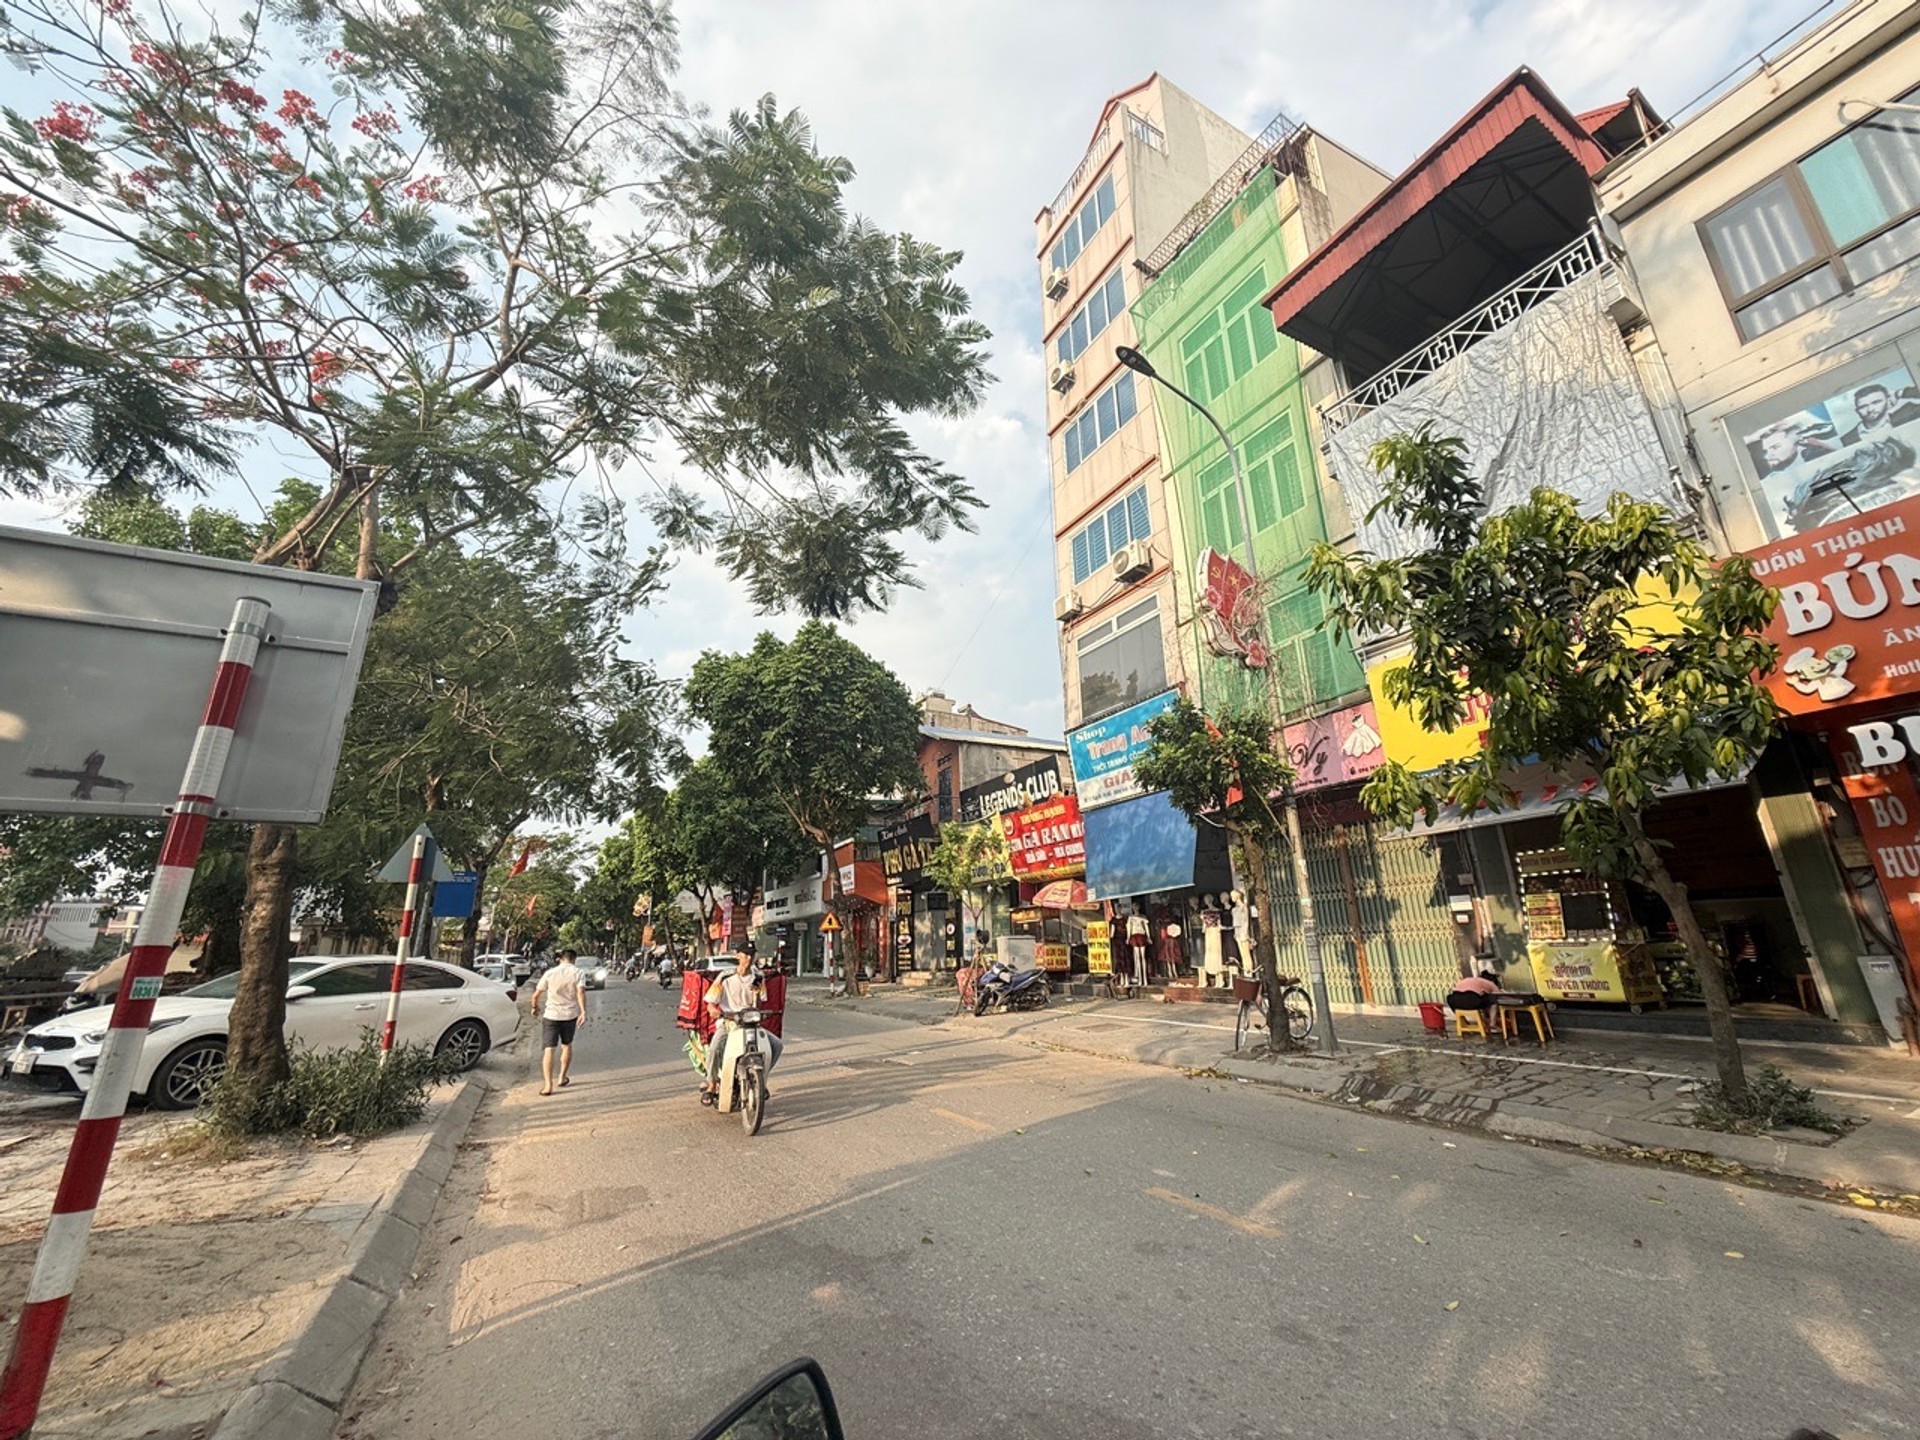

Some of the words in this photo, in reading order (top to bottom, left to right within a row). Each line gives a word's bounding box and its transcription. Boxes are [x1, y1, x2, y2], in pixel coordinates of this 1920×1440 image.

[1812, 516, 1906, 558] THÀNH
[1076, 726, 1106, 744] Shop
[1087, 733, 1128, 760] Trang
[1026, 769, 1059, 801] CLUB
[1869, 787, 1908, 828] BÒ
[1022, 827, 1041, 849] GÀ
[1041, 821, 1071, 846] RÁN
[903, 836, 920, 871] GÀ
